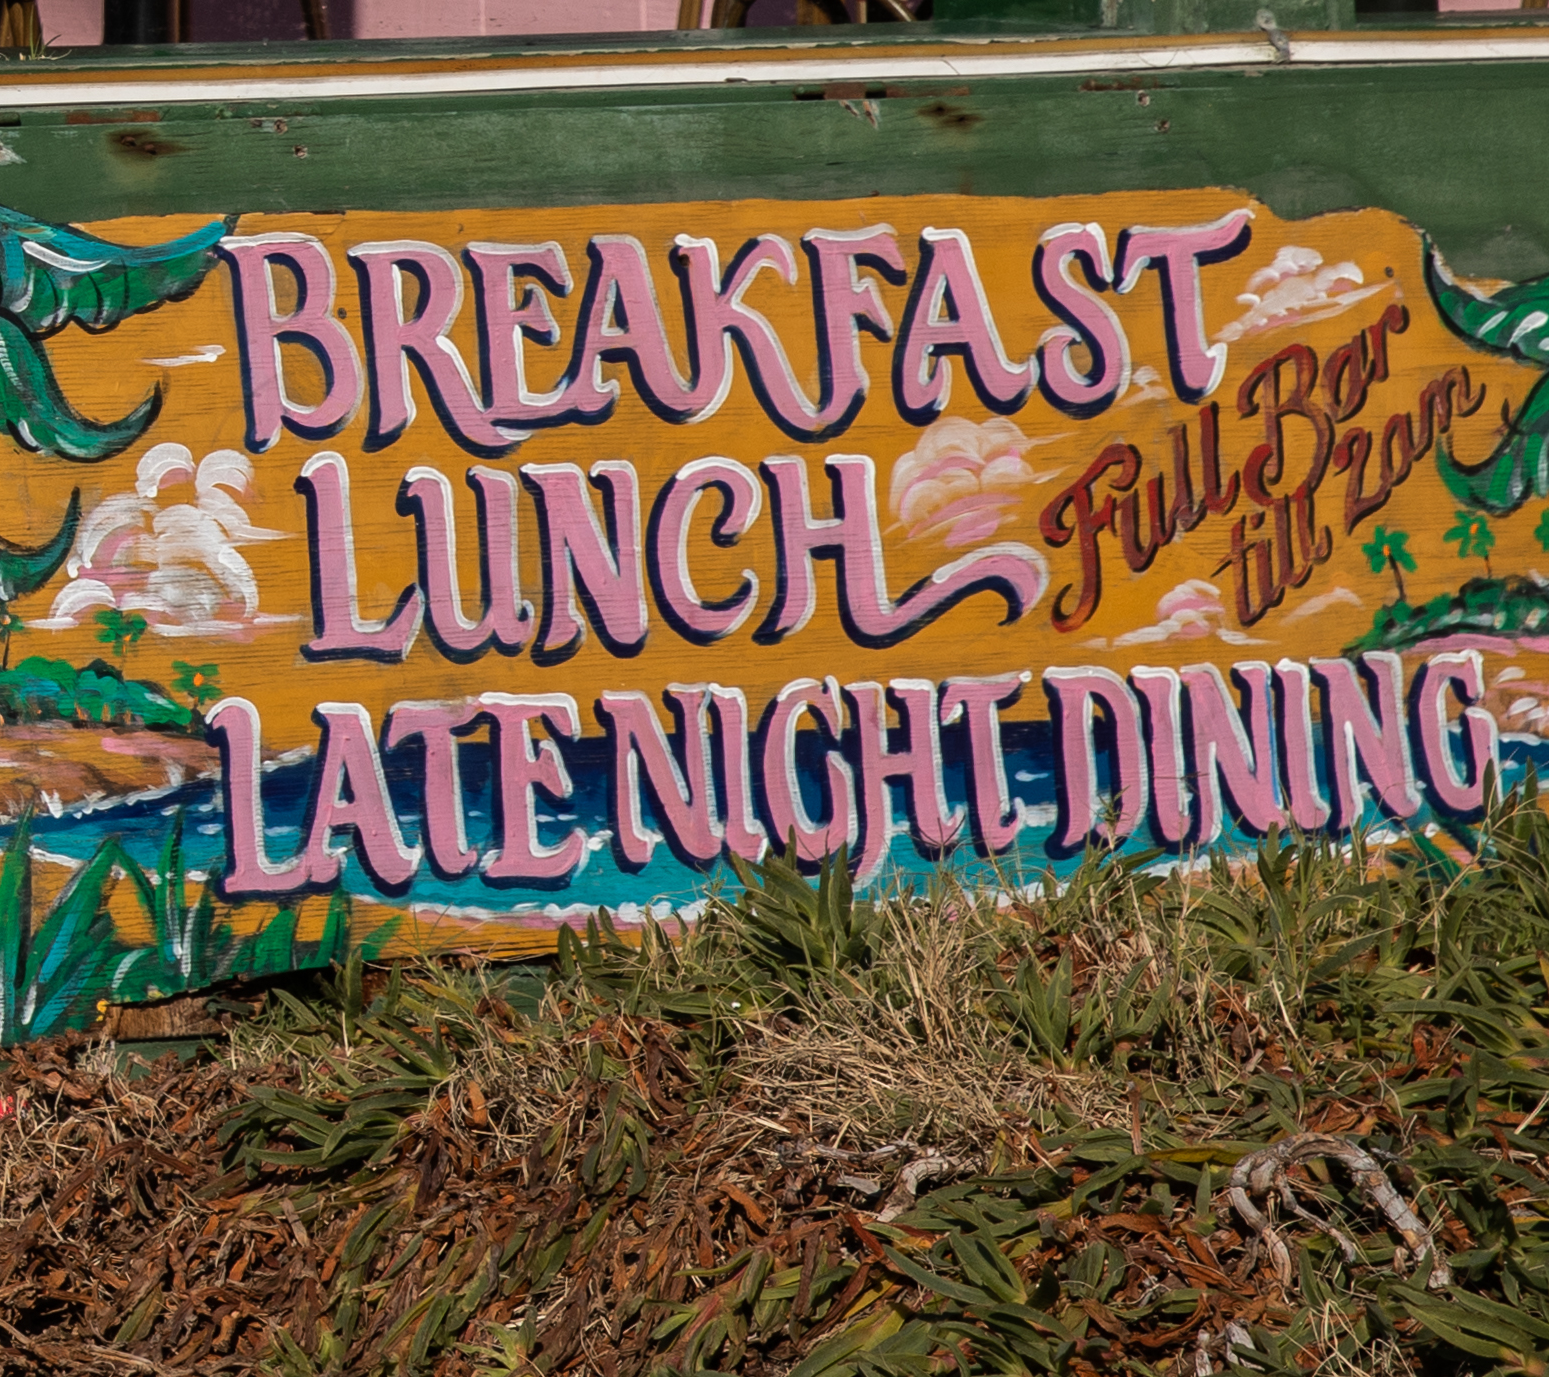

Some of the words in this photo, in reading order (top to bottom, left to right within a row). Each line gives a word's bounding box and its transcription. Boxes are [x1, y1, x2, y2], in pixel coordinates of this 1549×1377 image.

[217, 209, 1255, 456] BREAKFAST
[295, 450, 1050, 664] LUNCH
[1039, 402, 1241, 634] Full
[1236, 300, 1411, 503] Bar
[1217, 486, 1334, 628] till
[1334, 361, 1486, 536] 2am
[205, 692, 585, 902] LATE
[597, 670, 1033, 891] NIGHT
[1037, 647, 1505, 858] DINING
